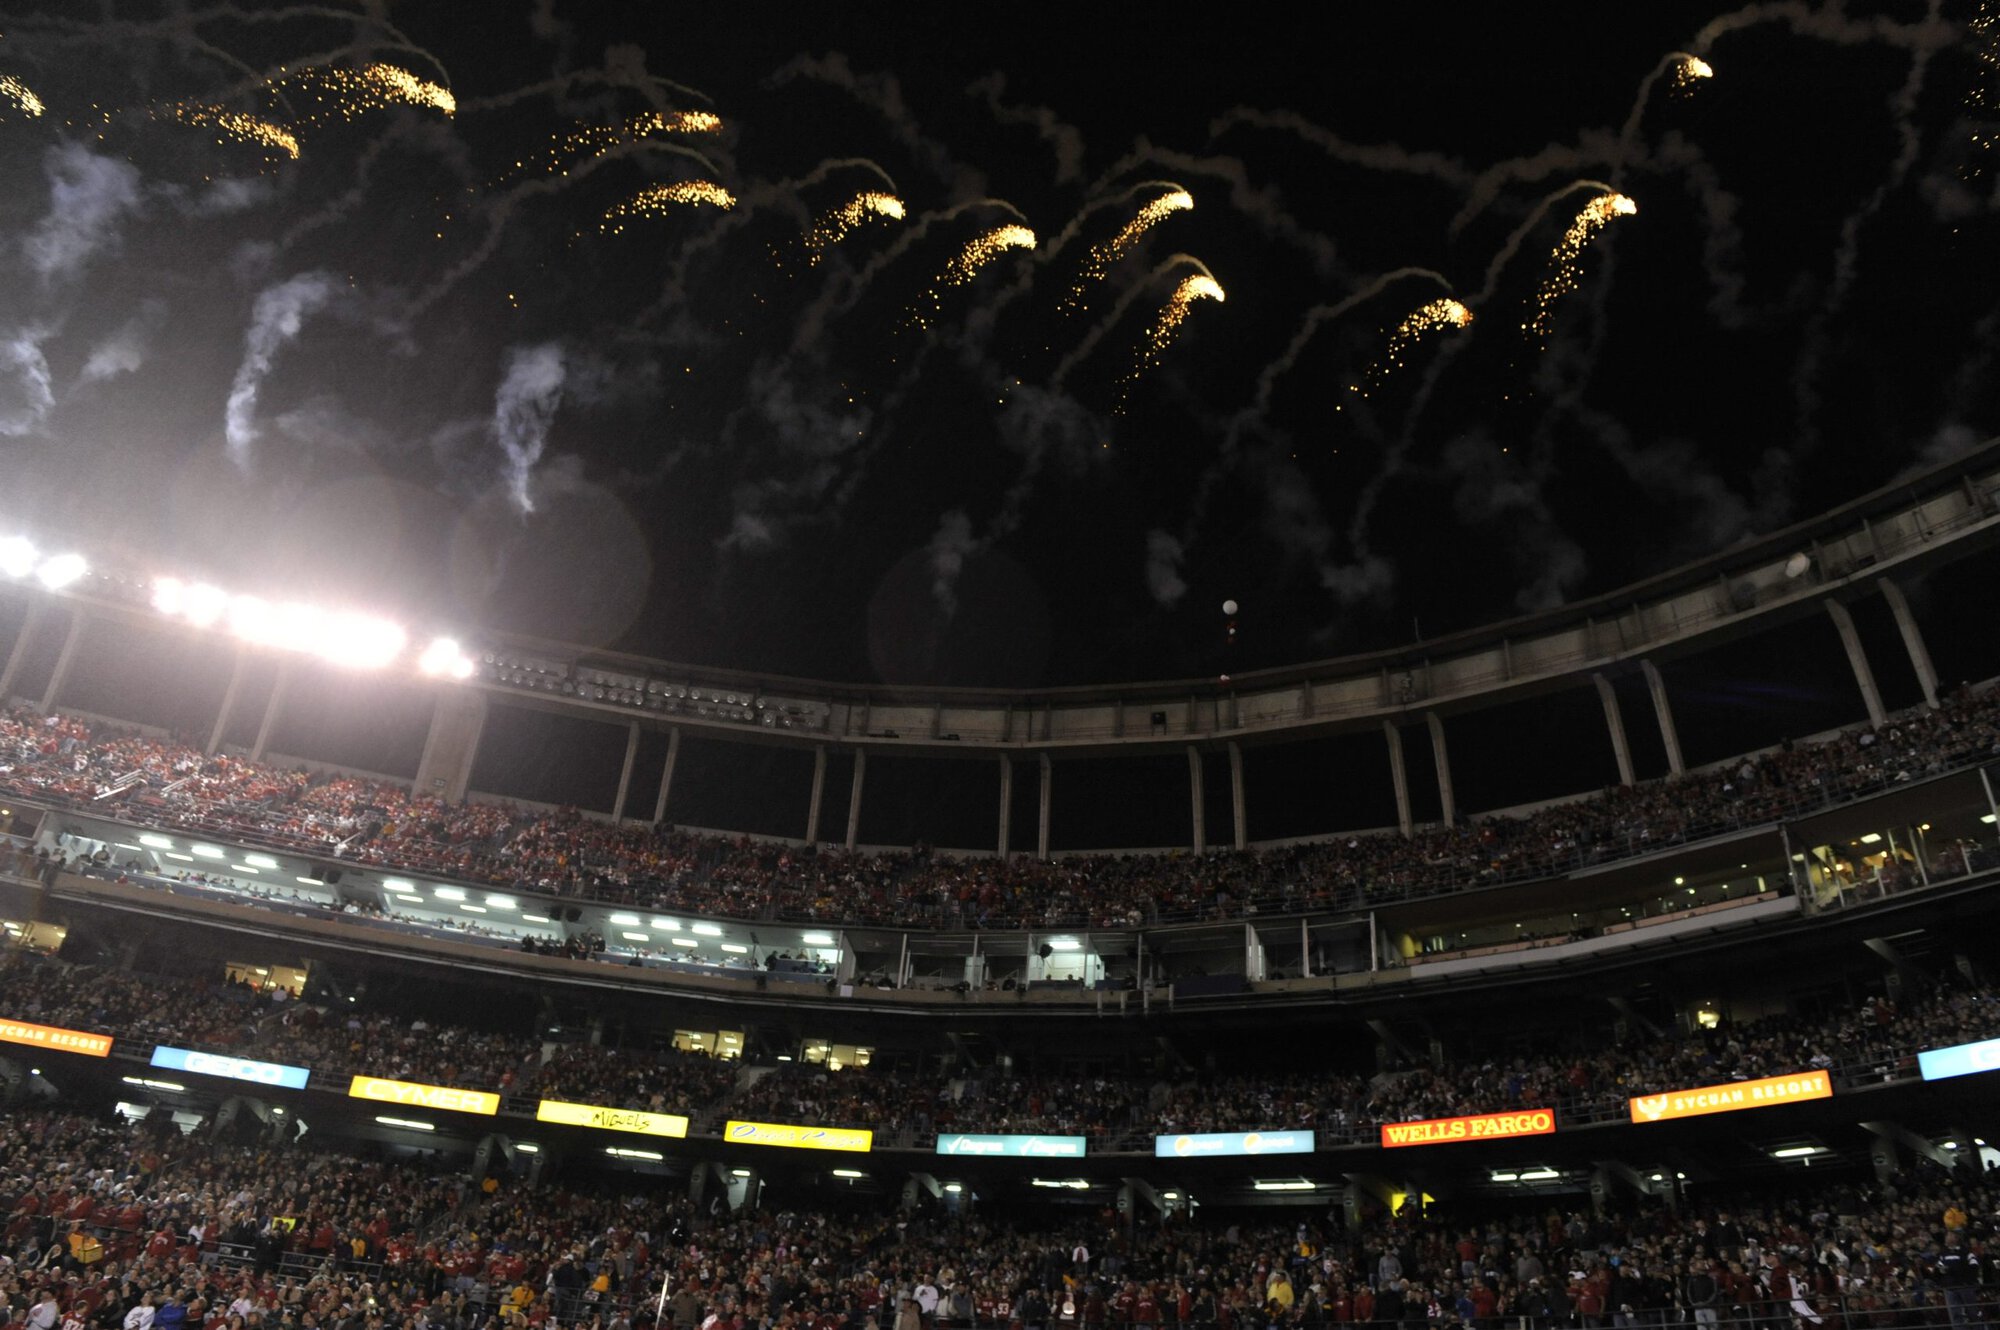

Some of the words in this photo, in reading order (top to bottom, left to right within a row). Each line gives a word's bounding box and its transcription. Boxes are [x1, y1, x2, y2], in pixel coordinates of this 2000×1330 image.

[50, 1033, 108, 1051] RESORT
[365, 1080, 484, 1111] CYMER
[1674, 1090, 1743, 1111] SYCUAN
[1751, 1078, 1823, 1100] RESORT
[1386, 1120, 1466, 1144] WELLS
[1469, 1113, 1551, 1137] FARGO
